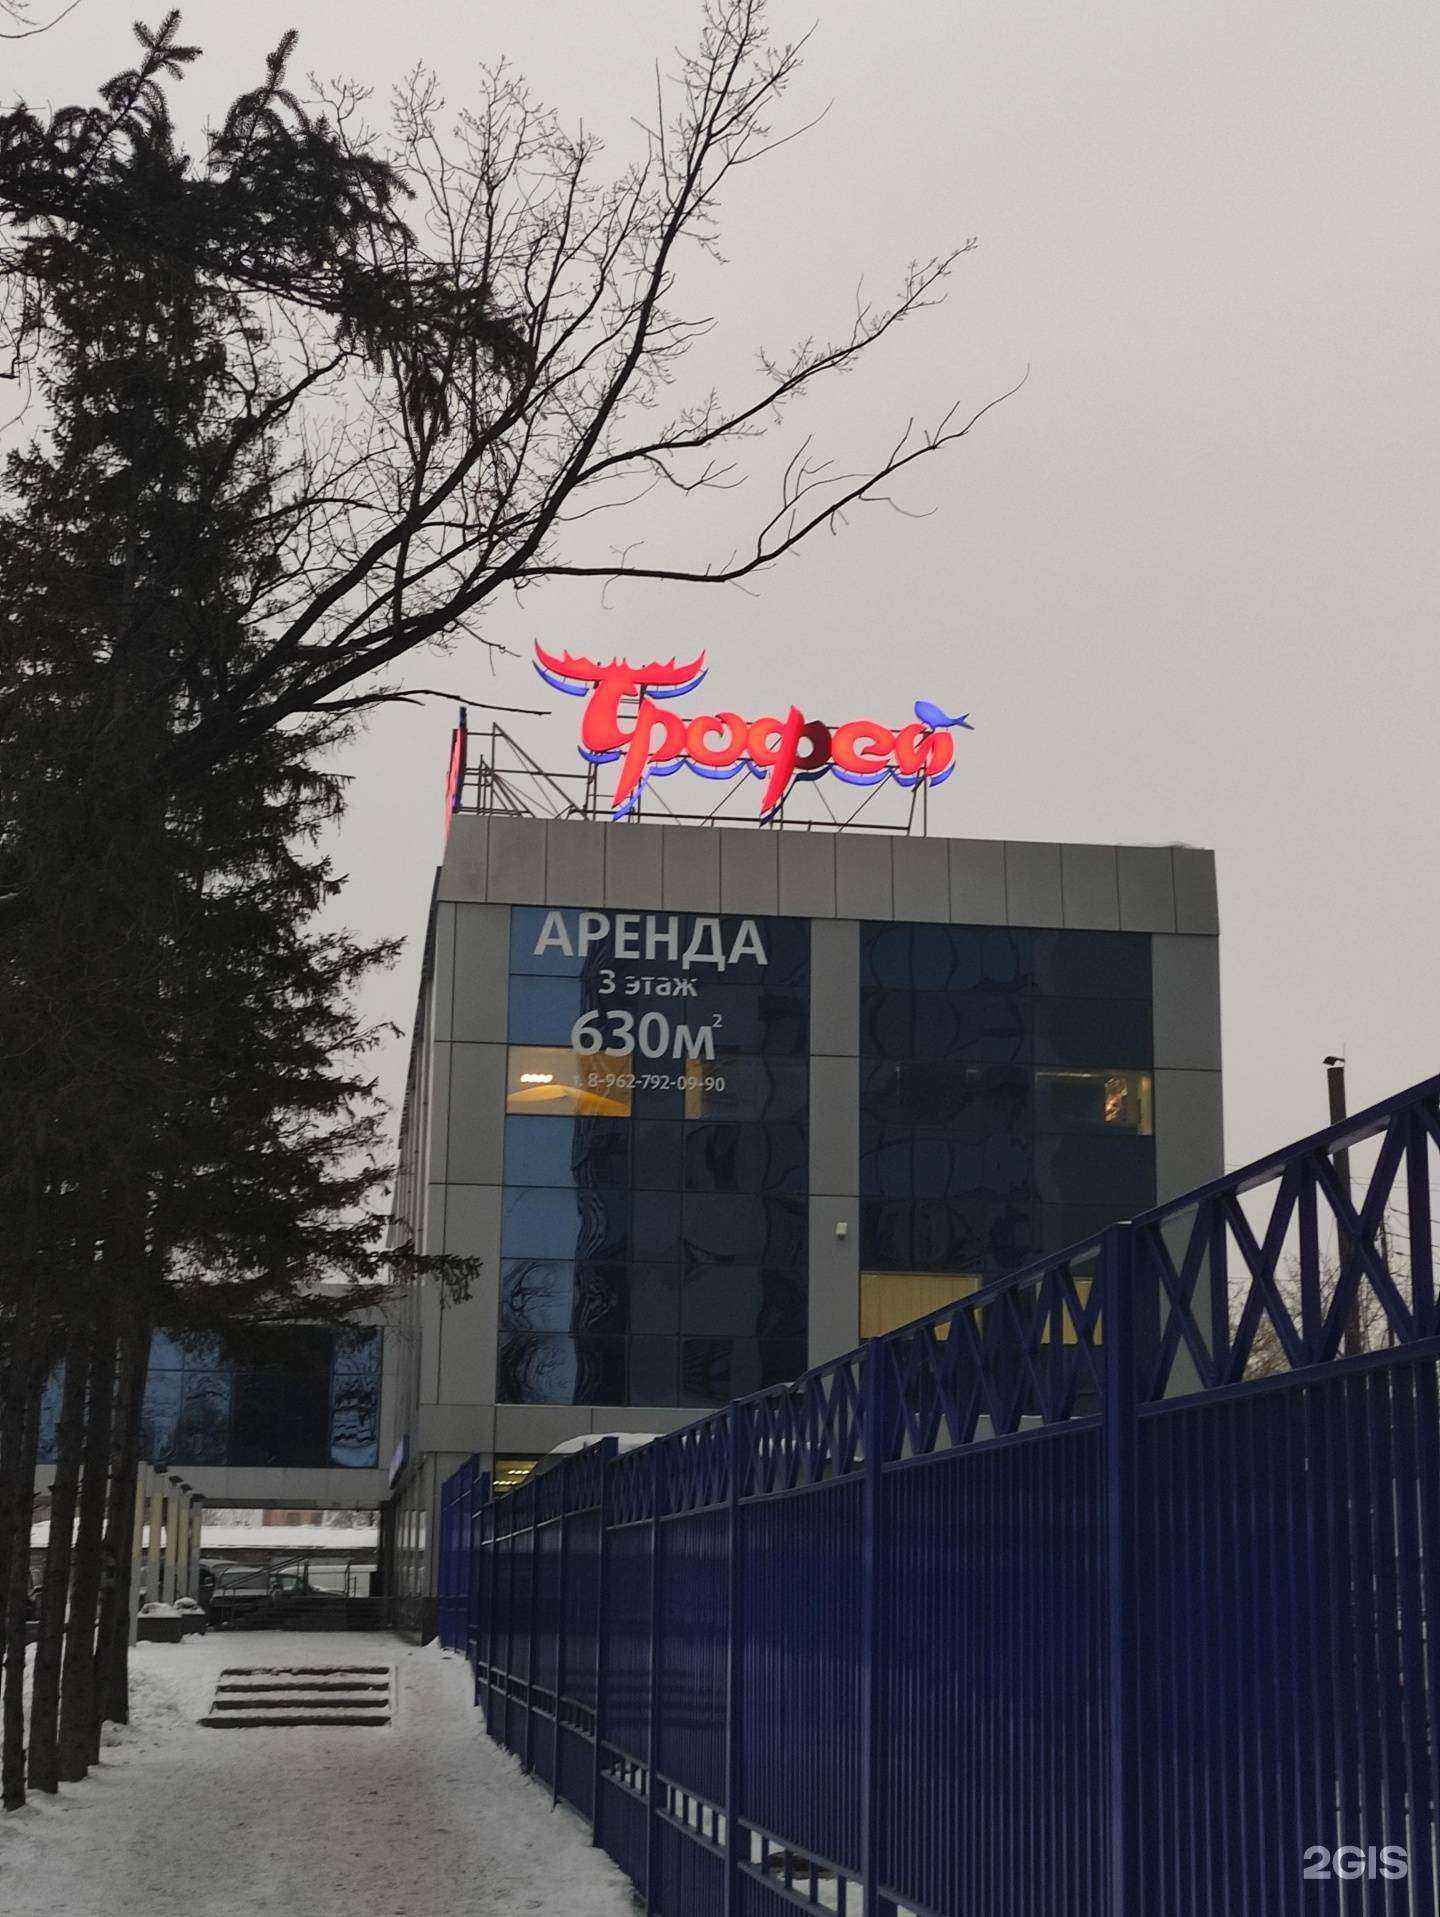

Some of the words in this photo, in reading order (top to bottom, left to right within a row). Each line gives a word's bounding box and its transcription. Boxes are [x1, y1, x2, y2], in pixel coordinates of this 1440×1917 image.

[532, 638, 974, 826] Трофей
[533, 910, 768, 972] АРЕНДА
[598, 969, 616, 995] 3
[624, 975, 699, 997] этаж
[587, 1072, 726, 1092] 8-962-792-09-90
